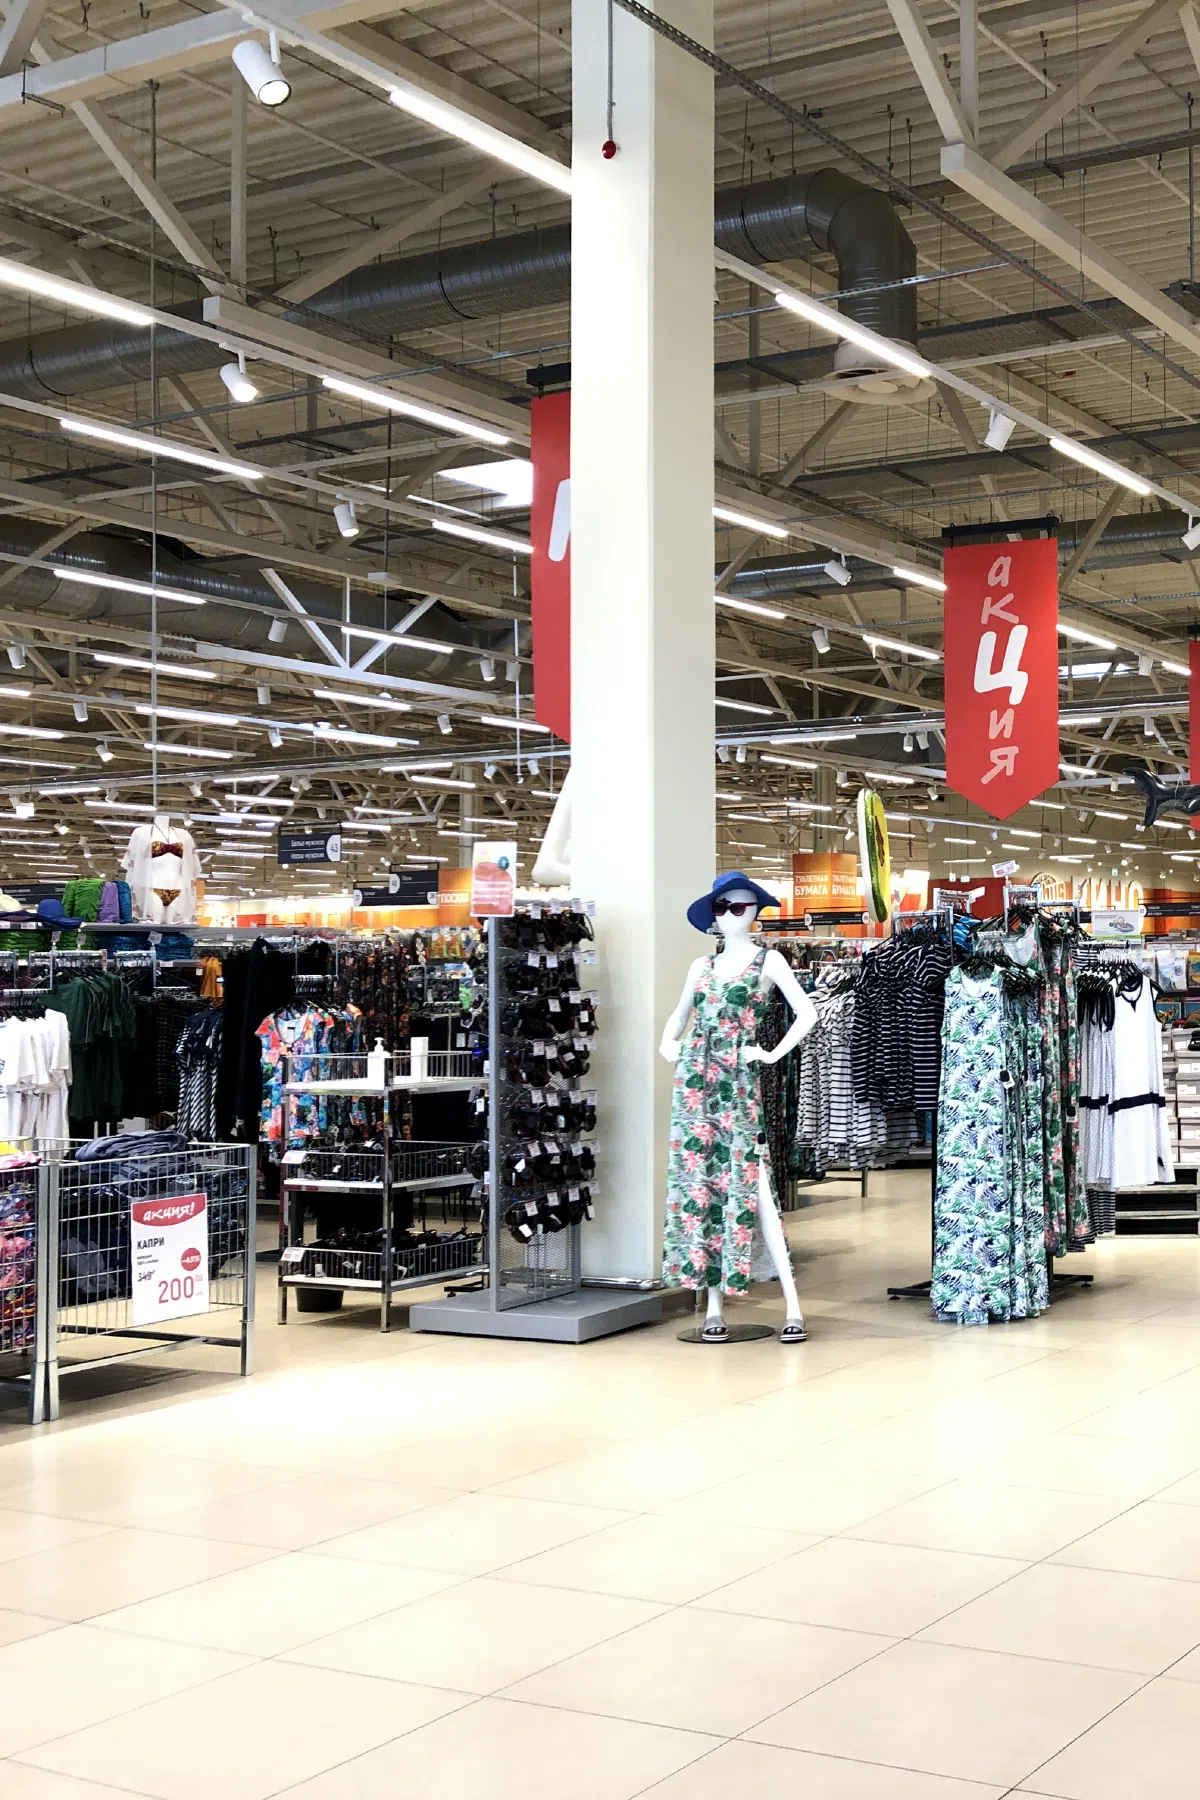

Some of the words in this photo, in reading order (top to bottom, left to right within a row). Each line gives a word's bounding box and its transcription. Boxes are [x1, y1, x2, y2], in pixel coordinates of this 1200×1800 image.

[794, 874, 829, 884] ТУАЛЕТНАЯ
[794, 885, 829, 896] БУМАГА
[143, 1201, 195, 1222] акция!
[137, 1237, 165, 1250] КАПРИ
[158, 1275, 194, 1304] 200
